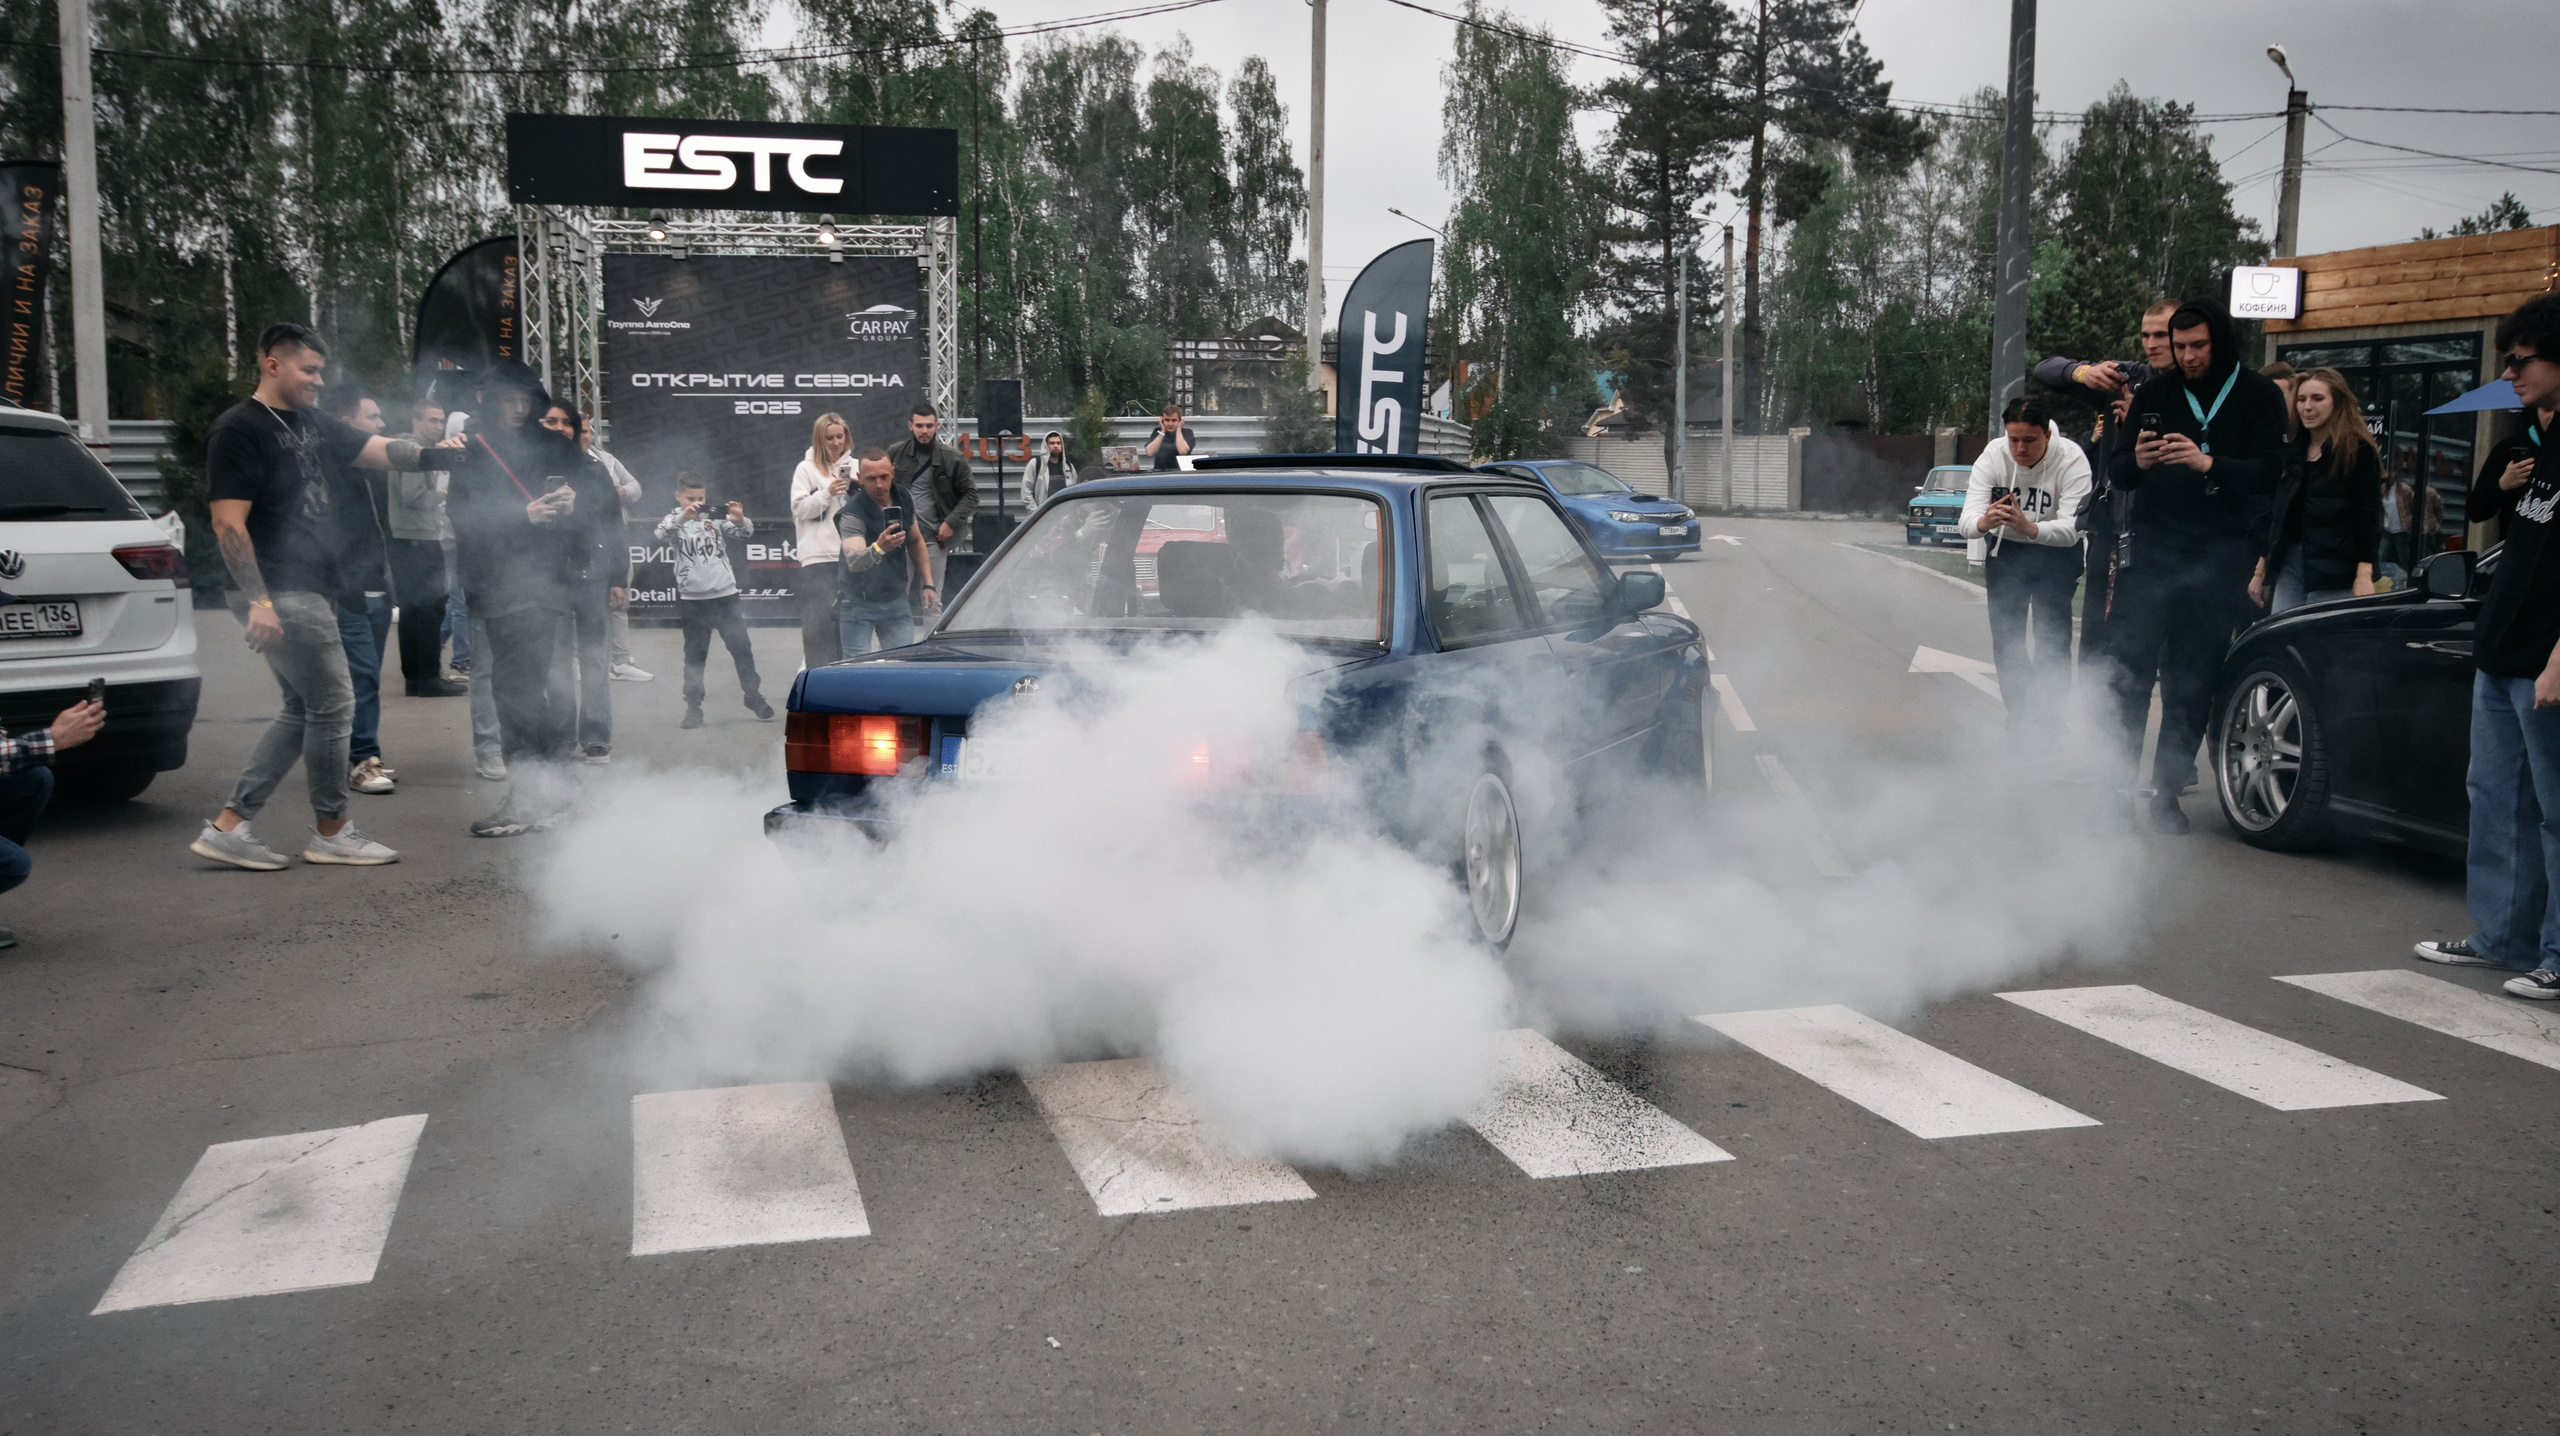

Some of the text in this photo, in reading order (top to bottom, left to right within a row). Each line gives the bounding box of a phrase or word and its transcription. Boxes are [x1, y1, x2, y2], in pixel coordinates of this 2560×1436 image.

[623, 133, 844, 194] ESTC
[19, 186, 44, 255] ЗАКАЗ
[16, 263, 36, 292] НА
[502, 255, 518, 310] ЗАКАЗ
[15, 299, 33, 315] И
[2239, 302, 2287, 313] КОФЕЙНЯ
[500, 317, 513, 339] НА
[607, 320, 690, 329] Группа АвтоСпа
[850, 321, 909, 334] CAR PAY
[632, 374, 904, 387] ОТКРЫТИЕ СЕЗОНА
[735, 401, 801, 414] 2025
[2366, 419, 2384, 435] АЙ
[630, 588, 677, 601] Detail
[38, 605, 72, 623] 136
[941, 763, 959, 774] EST
